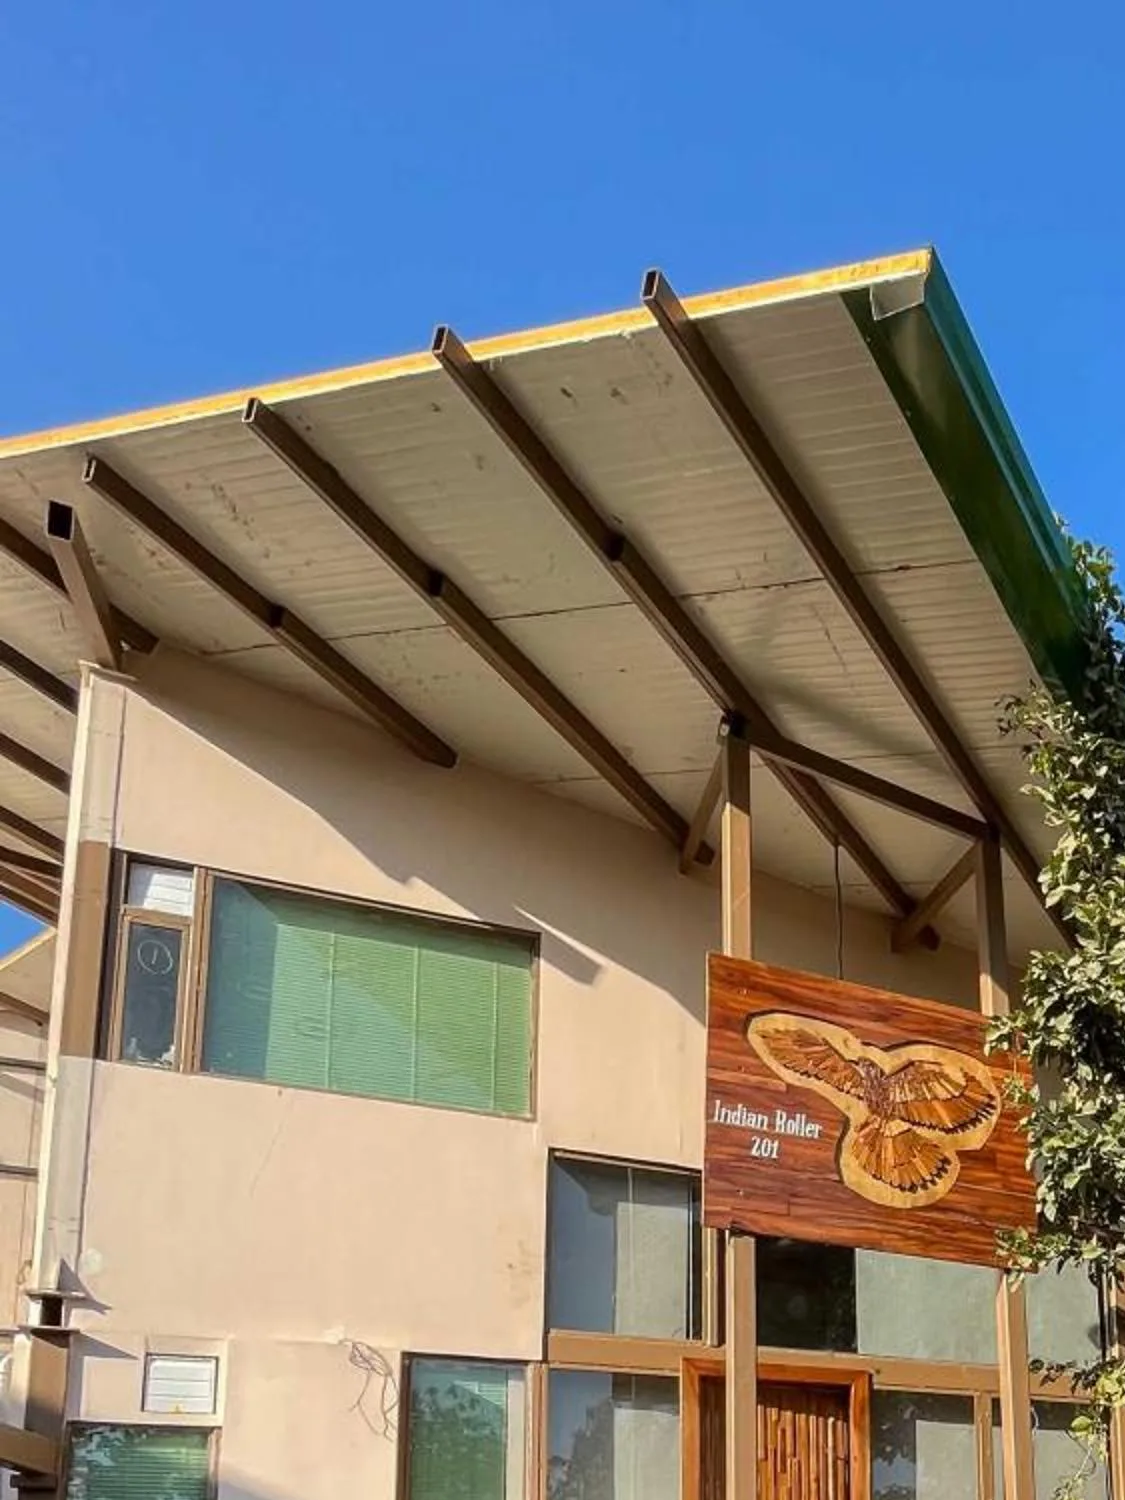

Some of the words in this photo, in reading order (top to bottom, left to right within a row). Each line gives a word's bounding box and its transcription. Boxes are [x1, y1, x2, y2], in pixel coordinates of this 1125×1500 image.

[713, 1099, 769, 1131] Indian
[775, 1109, 823, 1139] Roller
[751, 1135, 780, 1159] 201
